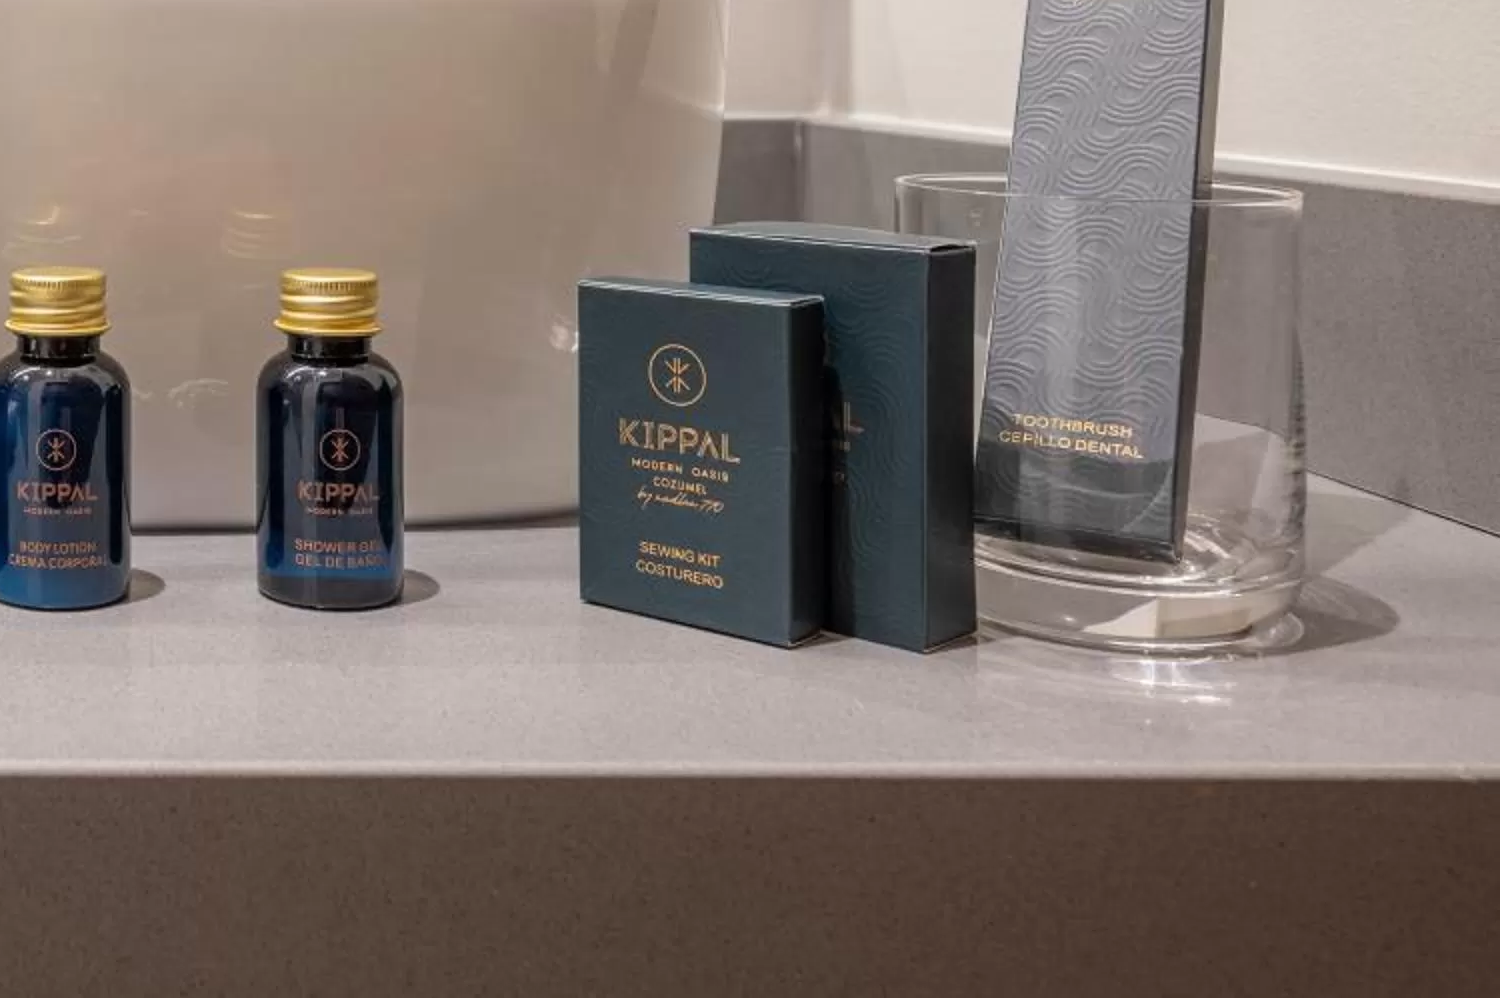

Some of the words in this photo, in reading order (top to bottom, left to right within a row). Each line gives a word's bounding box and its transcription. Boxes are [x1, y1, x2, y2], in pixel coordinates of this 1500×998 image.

[1012, 413, 1133, 439] TOOTHBRUSH
[618, 417, 741, 464] KIPPAL
[999, 430, 1071, 450] CEPILLO
[1074, 439, 1145, 459] DENTAL
[631, 457, 683, 474] MODERN
[691, 466, 729, 482] OASIS
[16, 481, 98, 502] KIPPAL
[297, 480, 380, 502] KIPPAL
[652, 476, 707, 495] COZUMEL
[19, 540, 52, 553] BODY
[54, 541, 97, 553] LOTION
[294, 539, 357, 553] SHOWER
[639, 540, 695, 563] SEWING
[697, 552, 721, 567] KIT
[295, 553, 323, 567] GEL
[325, 556, 345, 568] DE
[635, 559, 724, 589] COSTURERO
